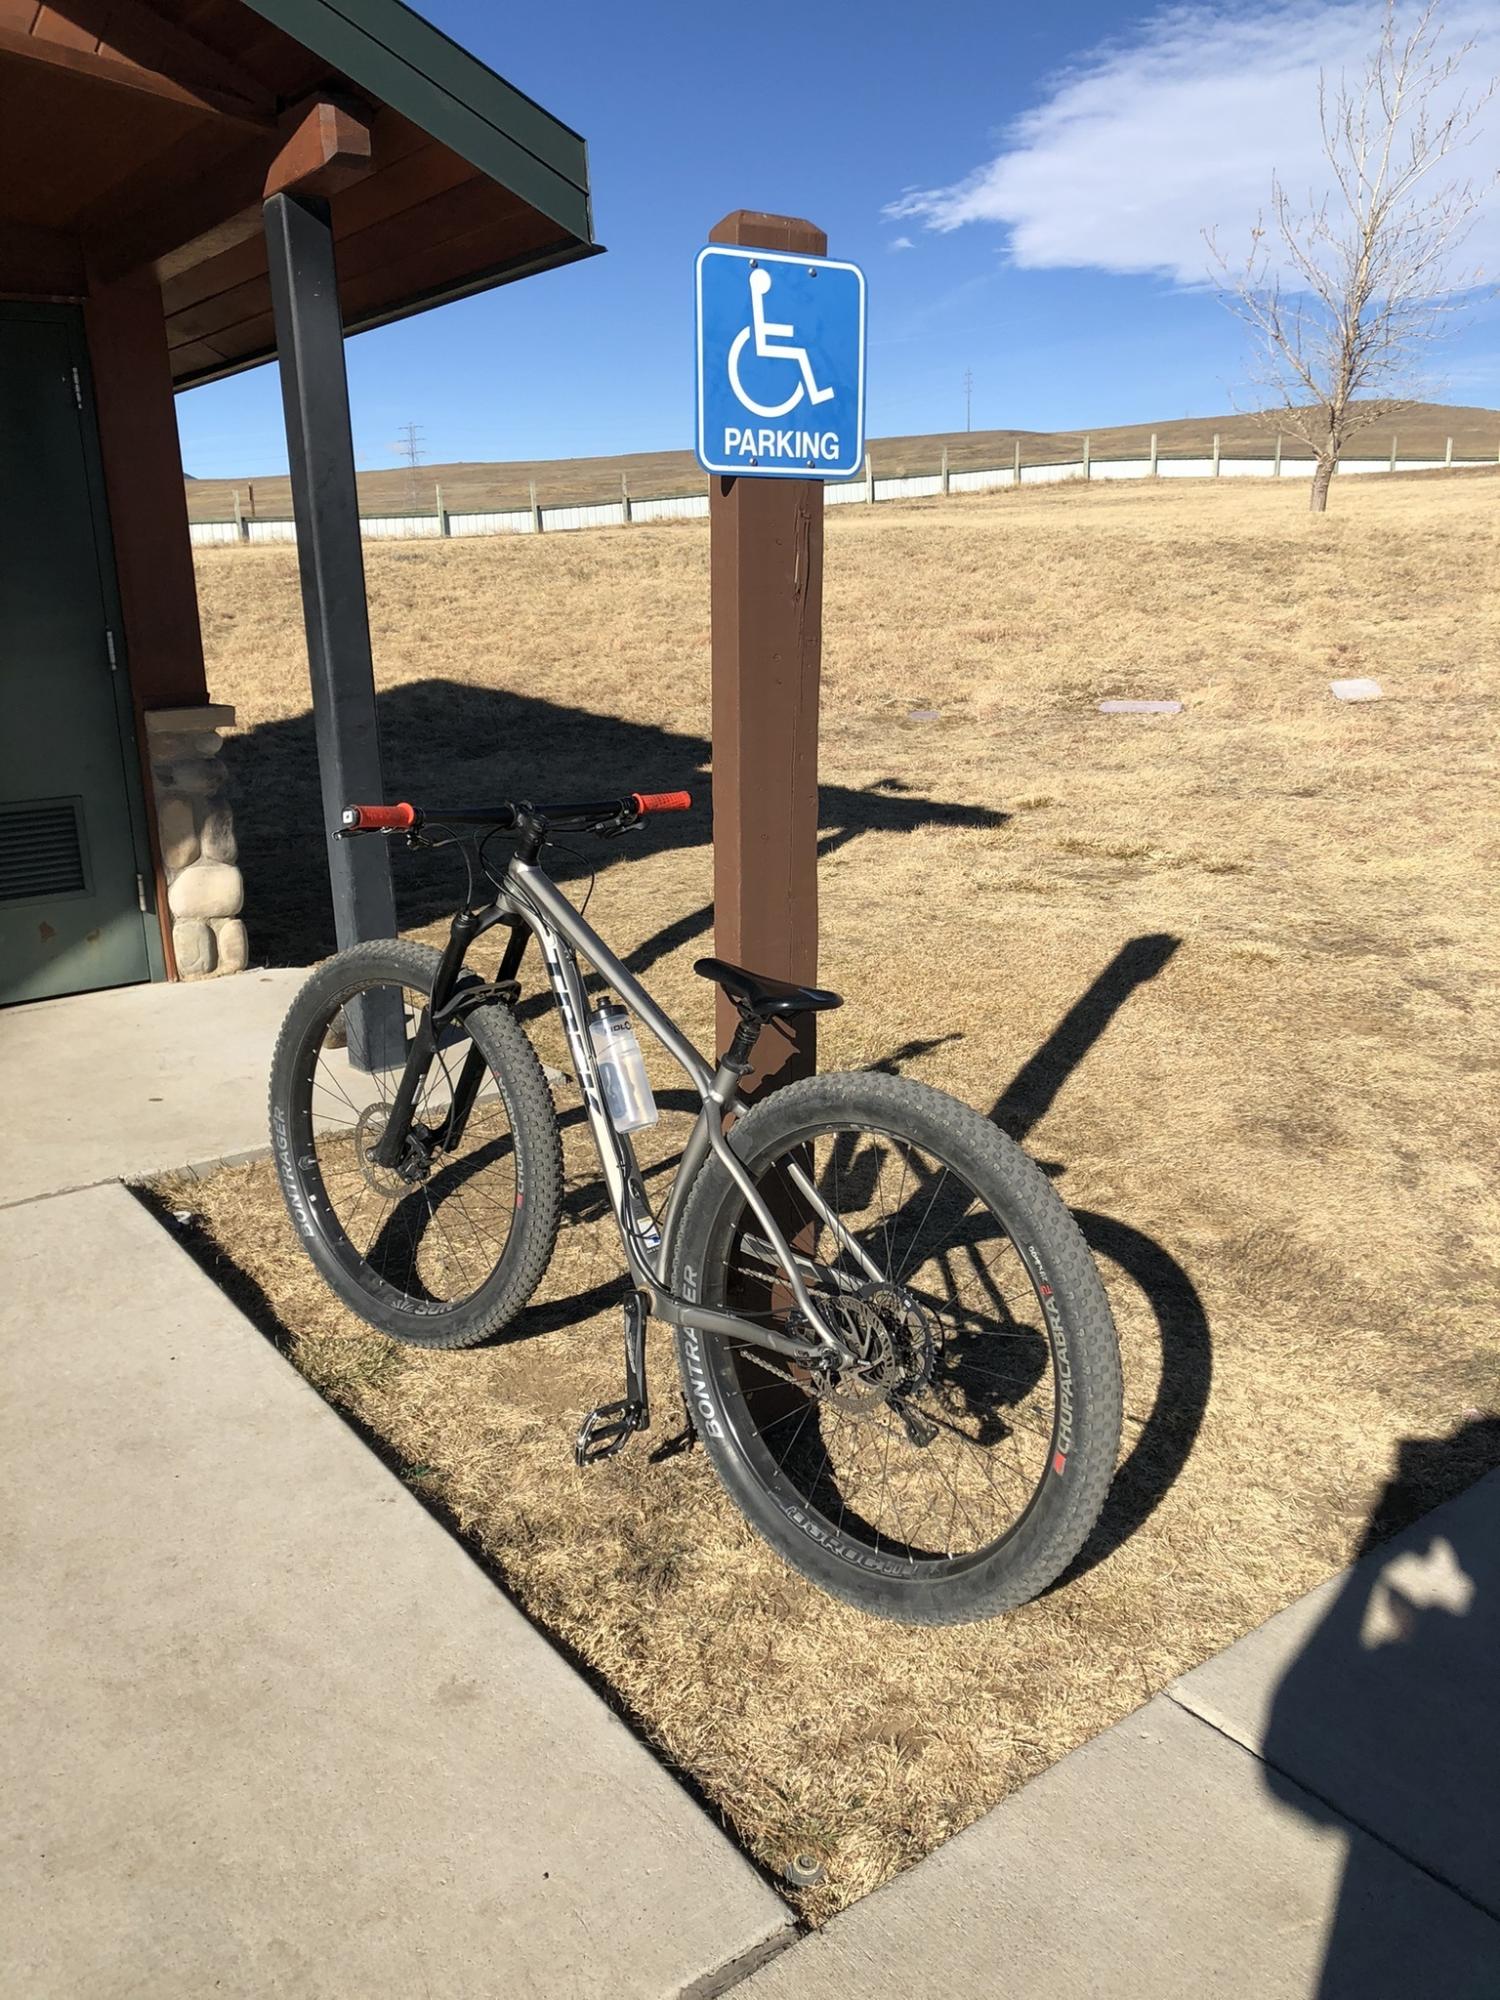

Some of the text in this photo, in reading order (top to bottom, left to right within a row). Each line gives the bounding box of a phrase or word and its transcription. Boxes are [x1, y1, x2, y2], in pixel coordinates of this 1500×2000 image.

[724, 427, 839, 460] PARKING
[682, 1264, 725, 1438] BONTRAER
[1045, 1295, 1074, 1454] CHUPACABRA
